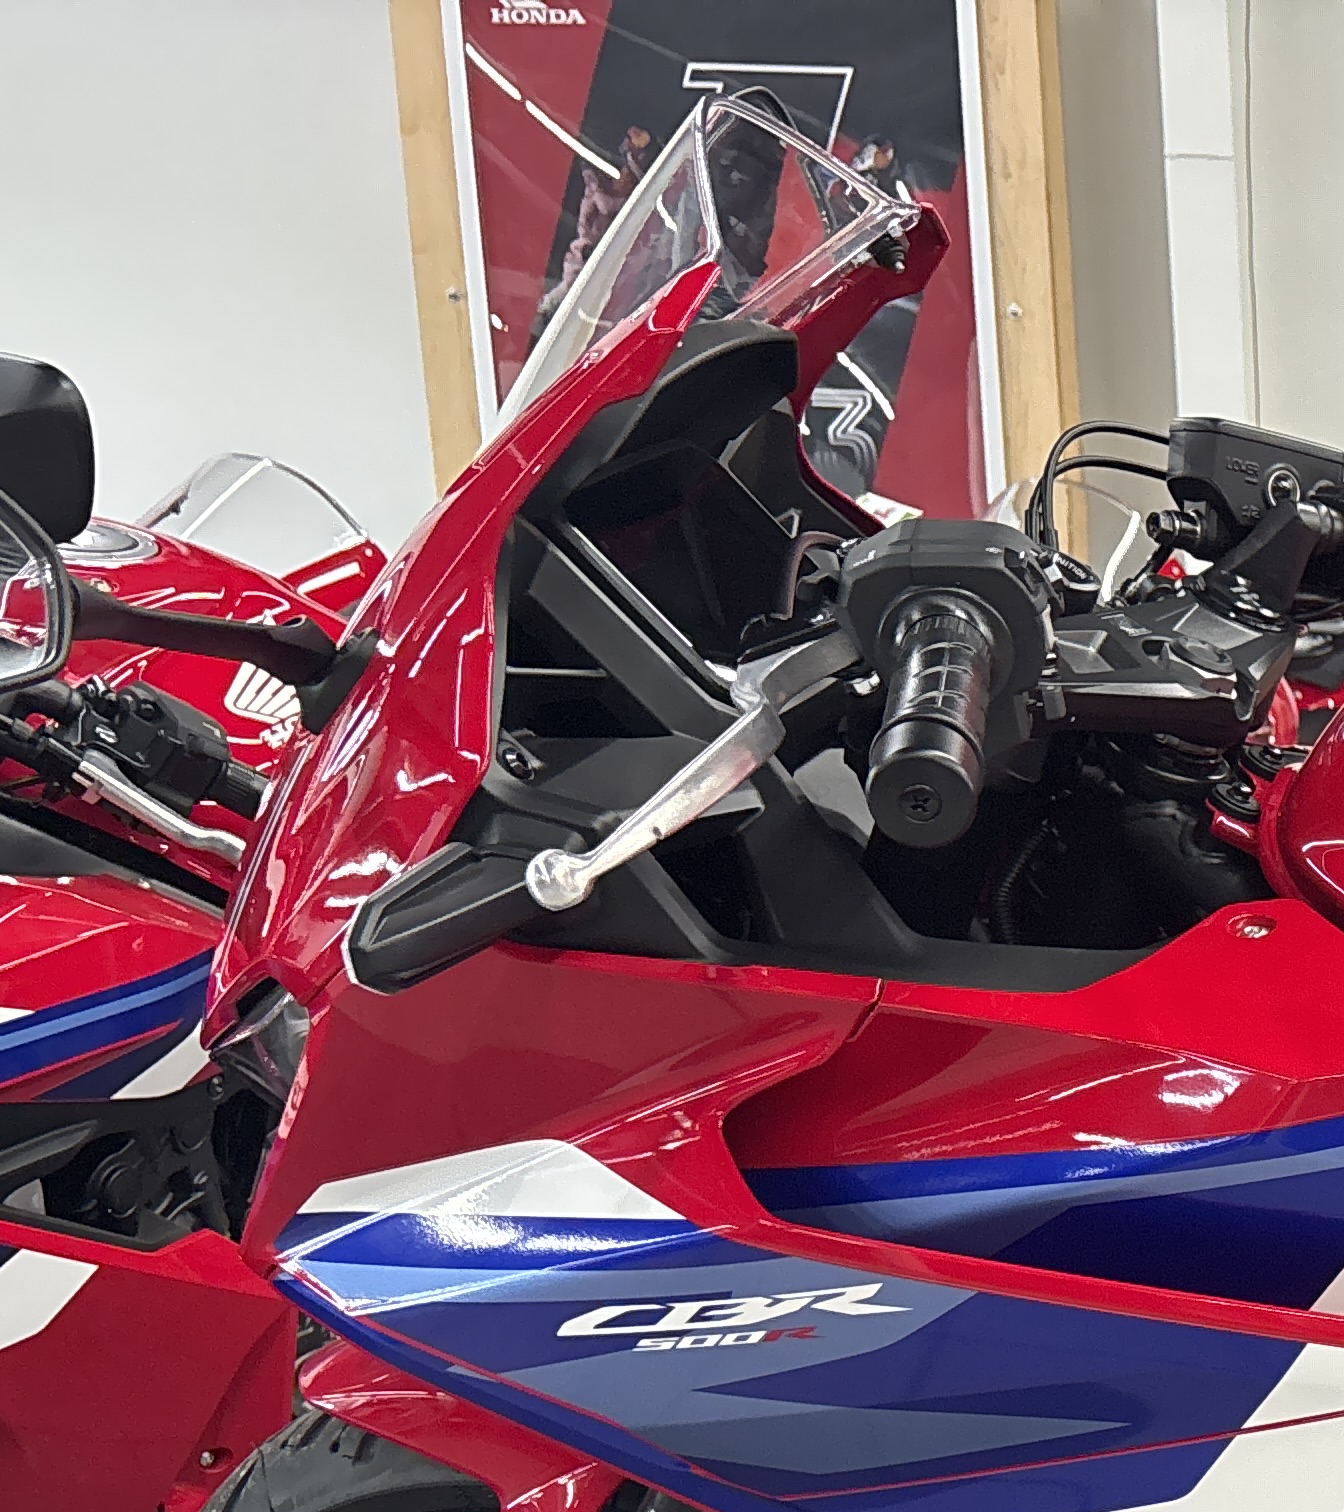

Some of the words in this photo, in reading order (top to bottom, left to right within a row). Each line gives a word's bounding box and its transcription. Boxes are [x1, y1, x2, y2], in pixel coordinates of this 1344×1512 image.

[490, 8, 586, 24] HONDA
[556, 1283, 913, 1337] CBR
[632, 1326, 826, 1352] 500R
